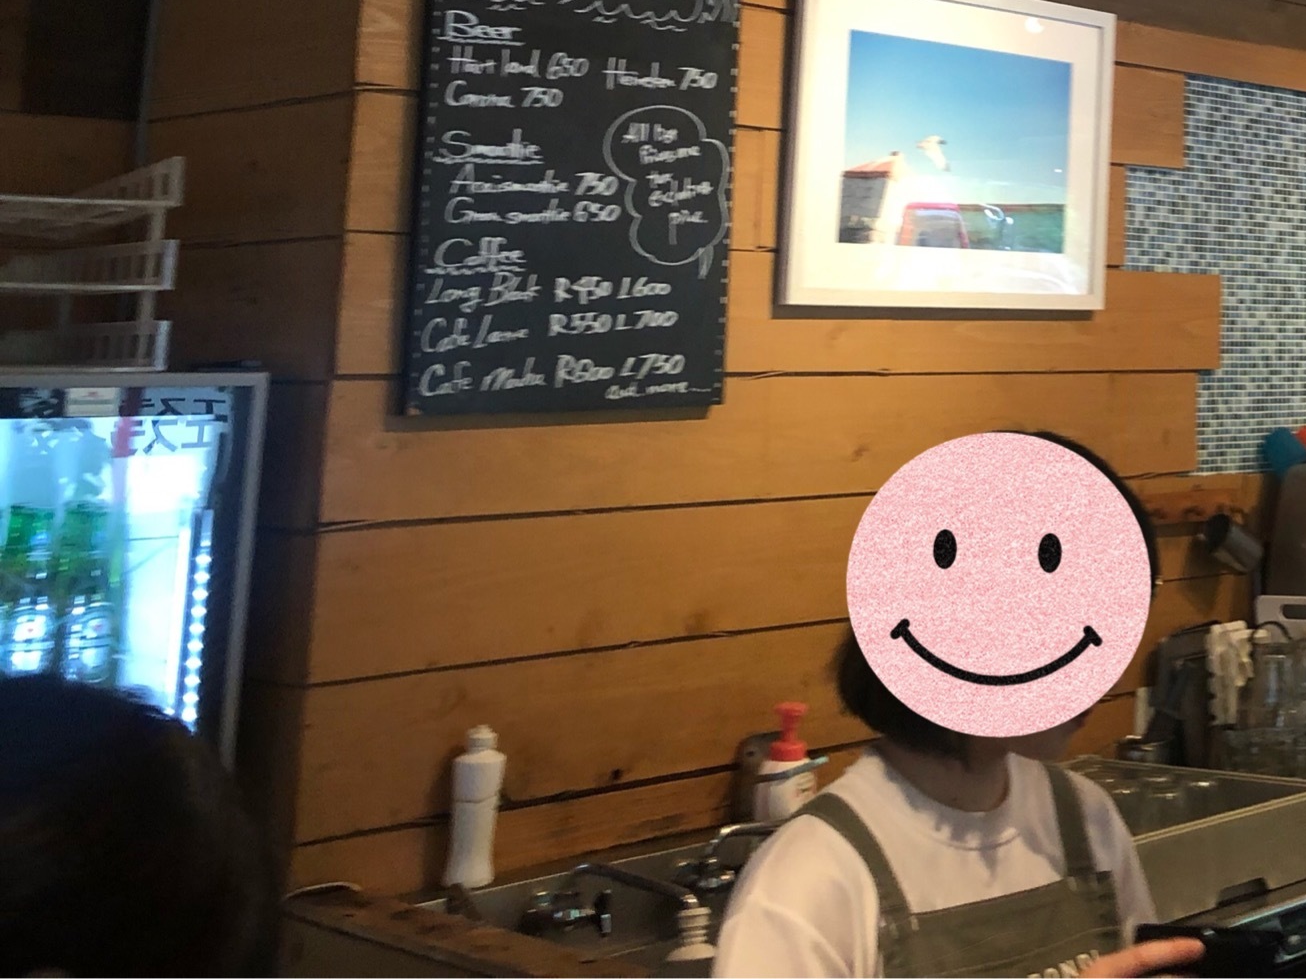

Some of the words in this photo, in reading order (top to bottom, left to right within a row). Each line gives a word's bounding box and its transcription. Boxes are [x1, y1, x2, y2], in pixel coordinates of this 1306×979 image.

[443, 10, 523, 40] Beer
[546, 52, 590, 80] 650
[678, 67, 719, 91] 750
[520, 87, 565, 108] 750
[574, 172, 620, 196] 750
[572, 201, 622, 222] 650
[433, 237, 526, 270] Coffee
[424, 278, 482, 313] Long
[618, 354, 686, 380] L750
